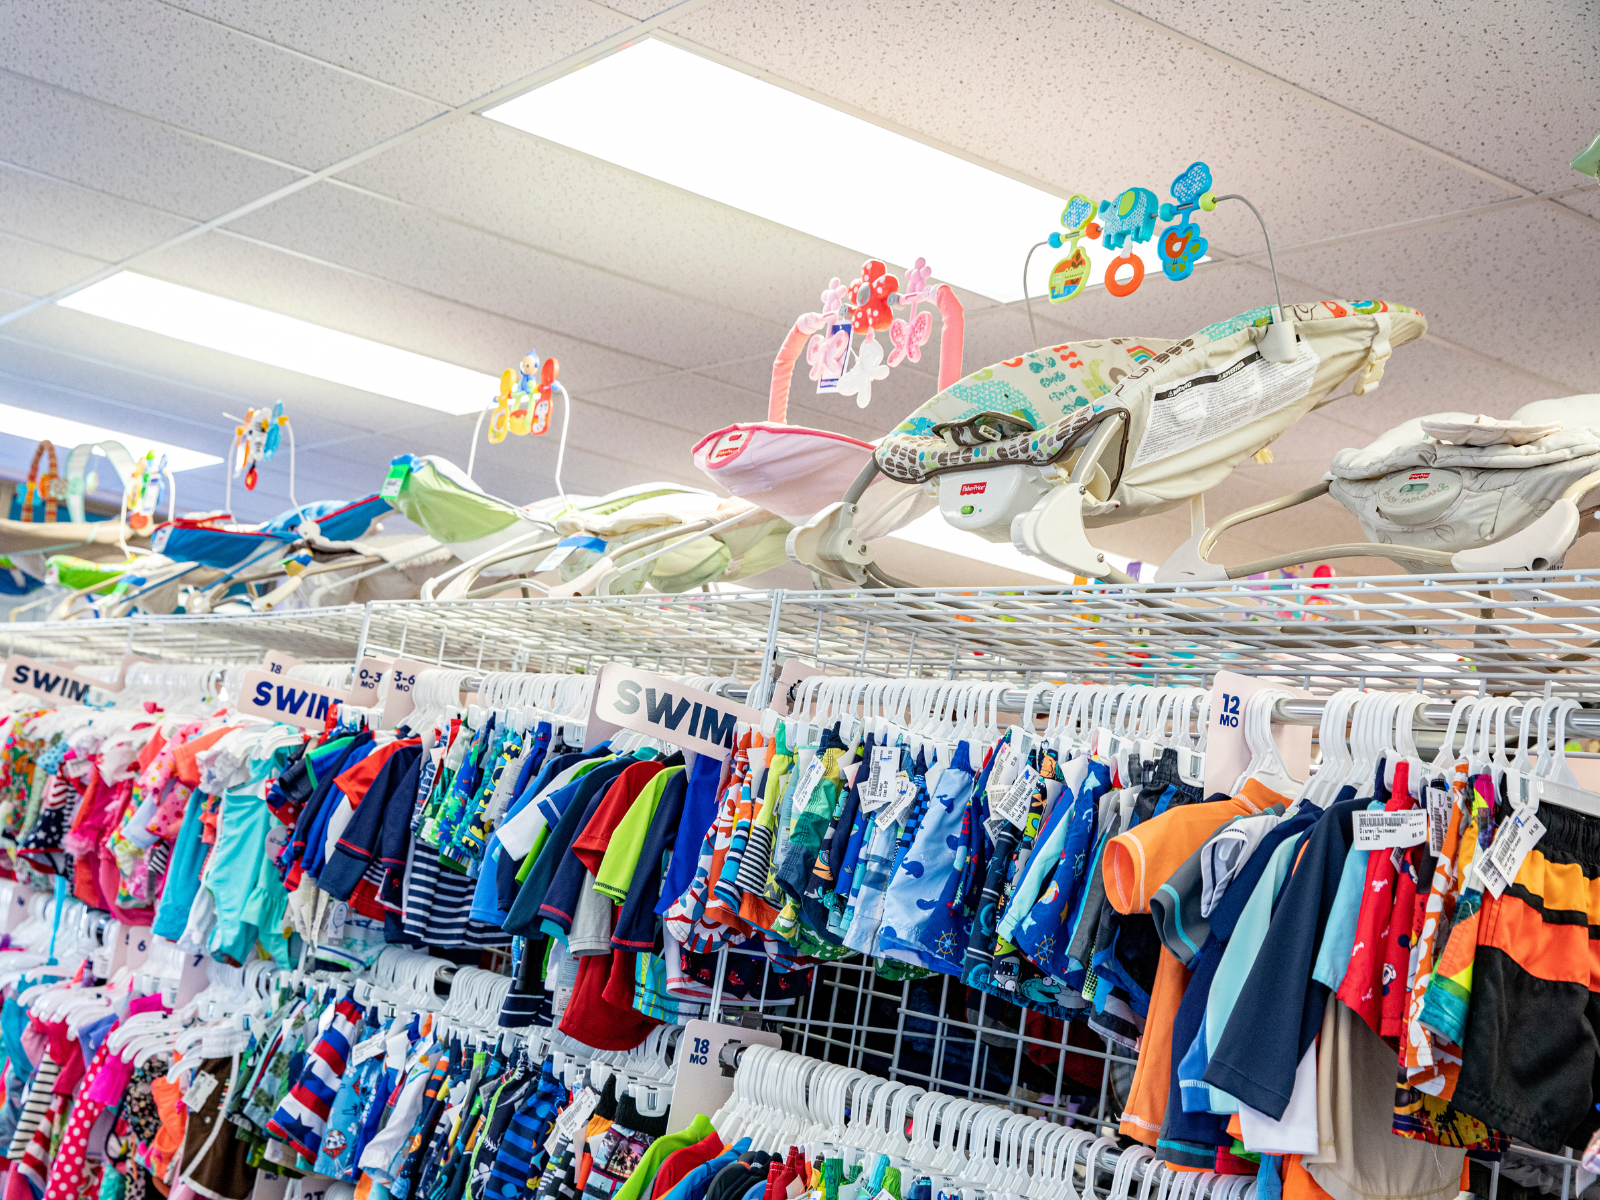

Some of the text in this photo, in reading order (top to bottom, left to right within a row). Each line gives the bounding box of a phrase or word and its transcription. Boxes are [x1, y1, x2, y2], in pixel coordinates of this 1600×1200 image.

[270, 662, 282, 674] 18
[12, 665, 90, 703] SWIM
[394, 670, 415, 685] 3-6
[361, 680, 374, 689] MO
[396, 683, 410, 692] MO
[1222, 693, 1240, 715] 12
[612, 680, 738, 750] SWIM
[1220, 714, 1238, 728] MO
[138, 940, 146, 951] 6
[193, 954, 204, 967] 7
[694, 1037, 710, 1054] 18
[689, 1054, 708, 1065] MO
